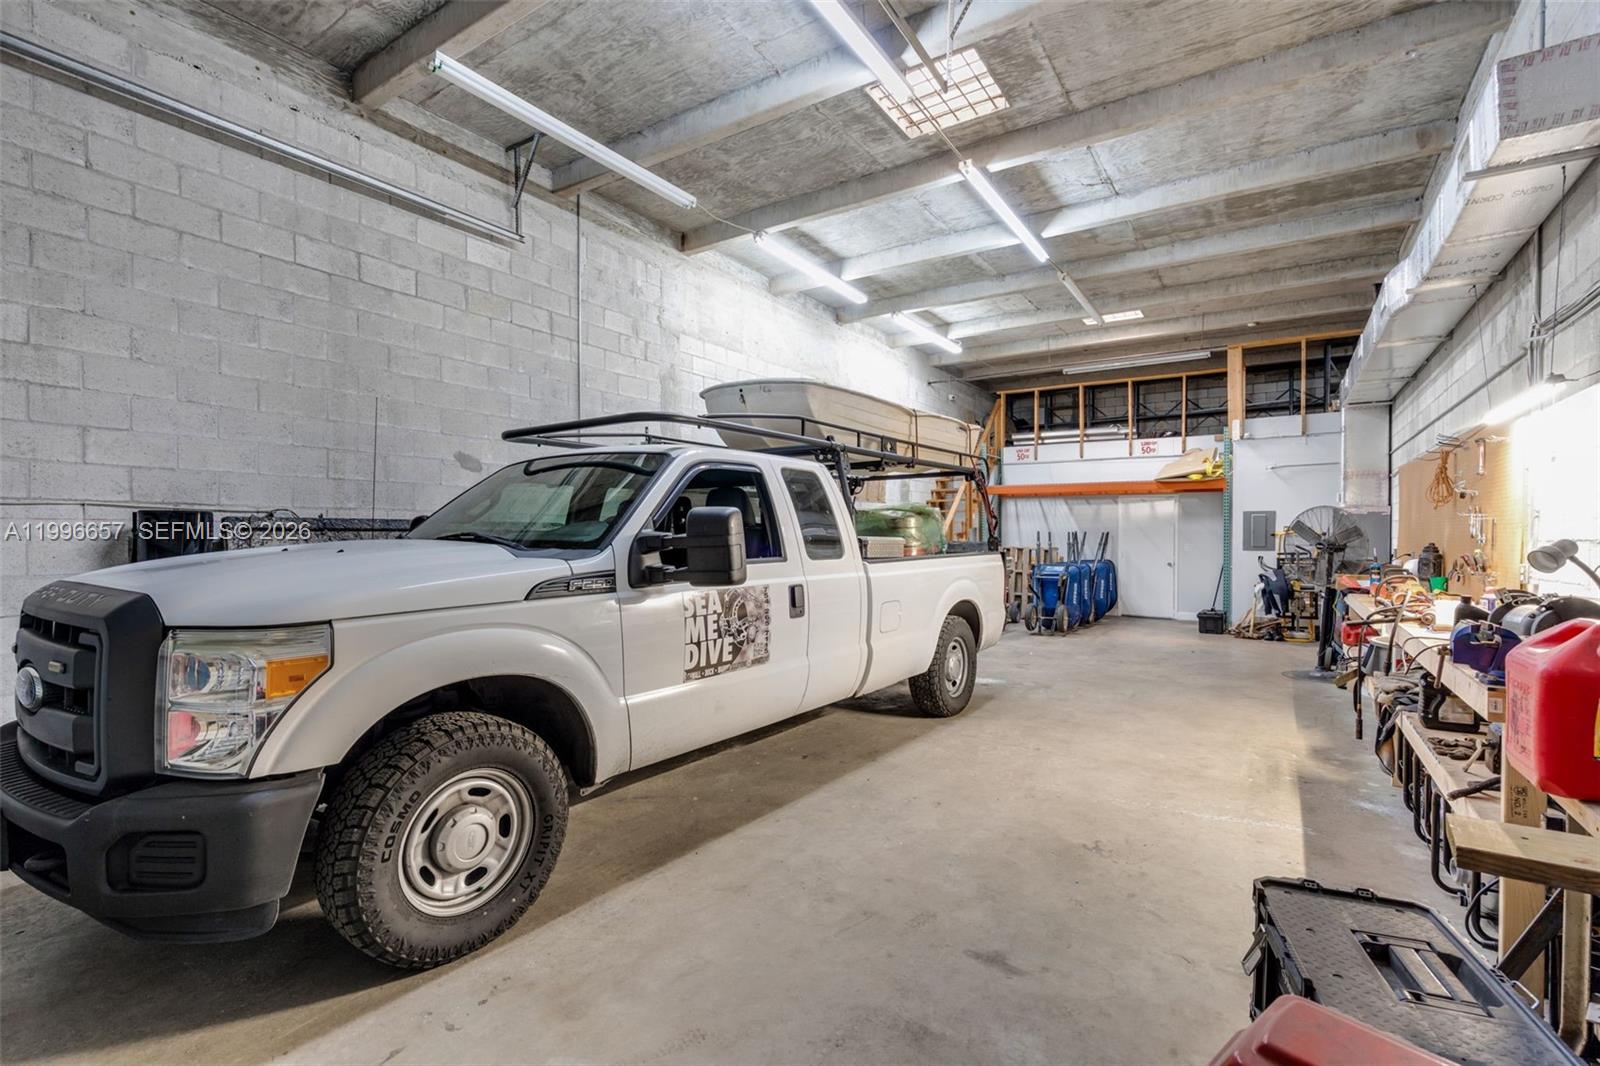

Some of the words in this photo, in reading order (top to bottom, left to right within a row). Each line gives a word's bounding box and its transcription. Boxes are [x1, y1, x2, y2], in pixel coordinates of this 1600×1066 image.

[683, 589, 723, 618] SEA
[684, 613, 719, 644] ME
[684, 636, 733, 672] DIVE
[380, 790, 422, 864] COSMO
[519, 871, 537, 894] XT
